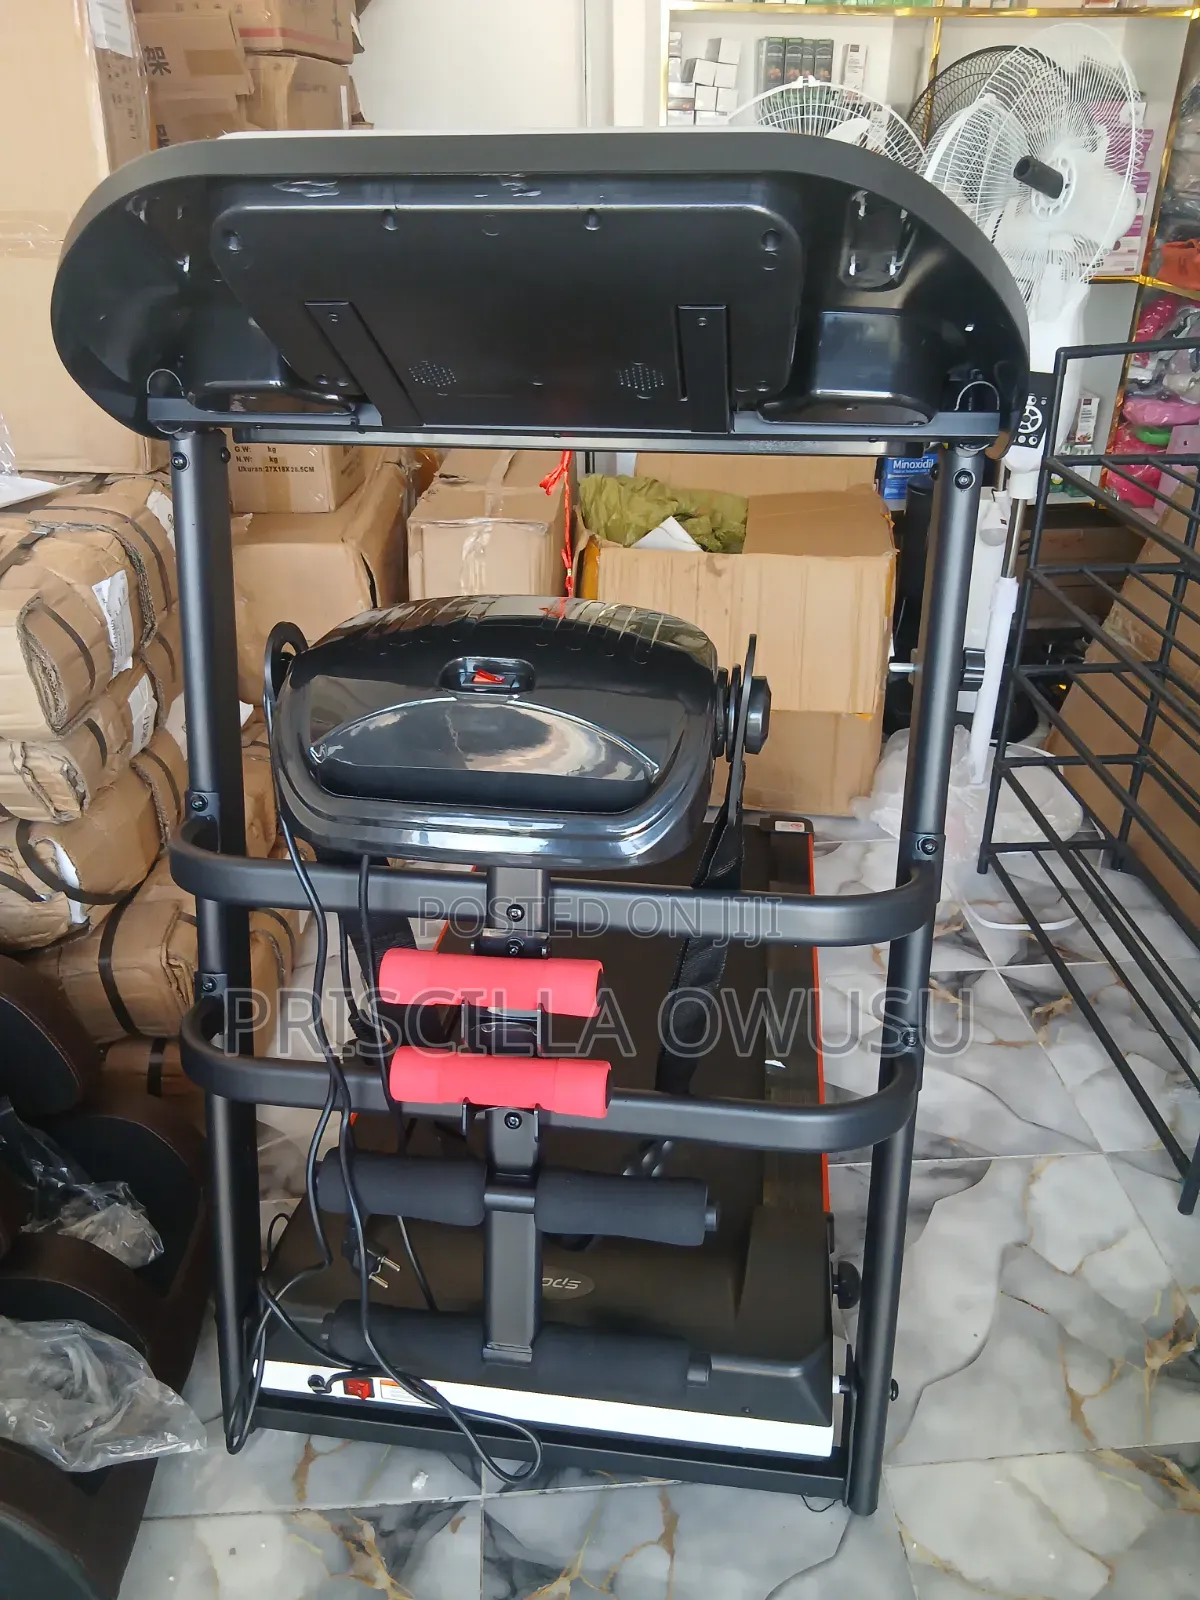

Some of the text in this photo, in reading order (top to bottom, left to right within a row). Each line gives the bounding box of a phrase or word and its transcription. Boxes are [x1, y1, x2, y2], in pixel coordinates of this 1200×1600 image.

[267, 446, 277, 454] kg
[268, 456, 279, 464] kg
[893, 459, 934, 469] Minoxidil
